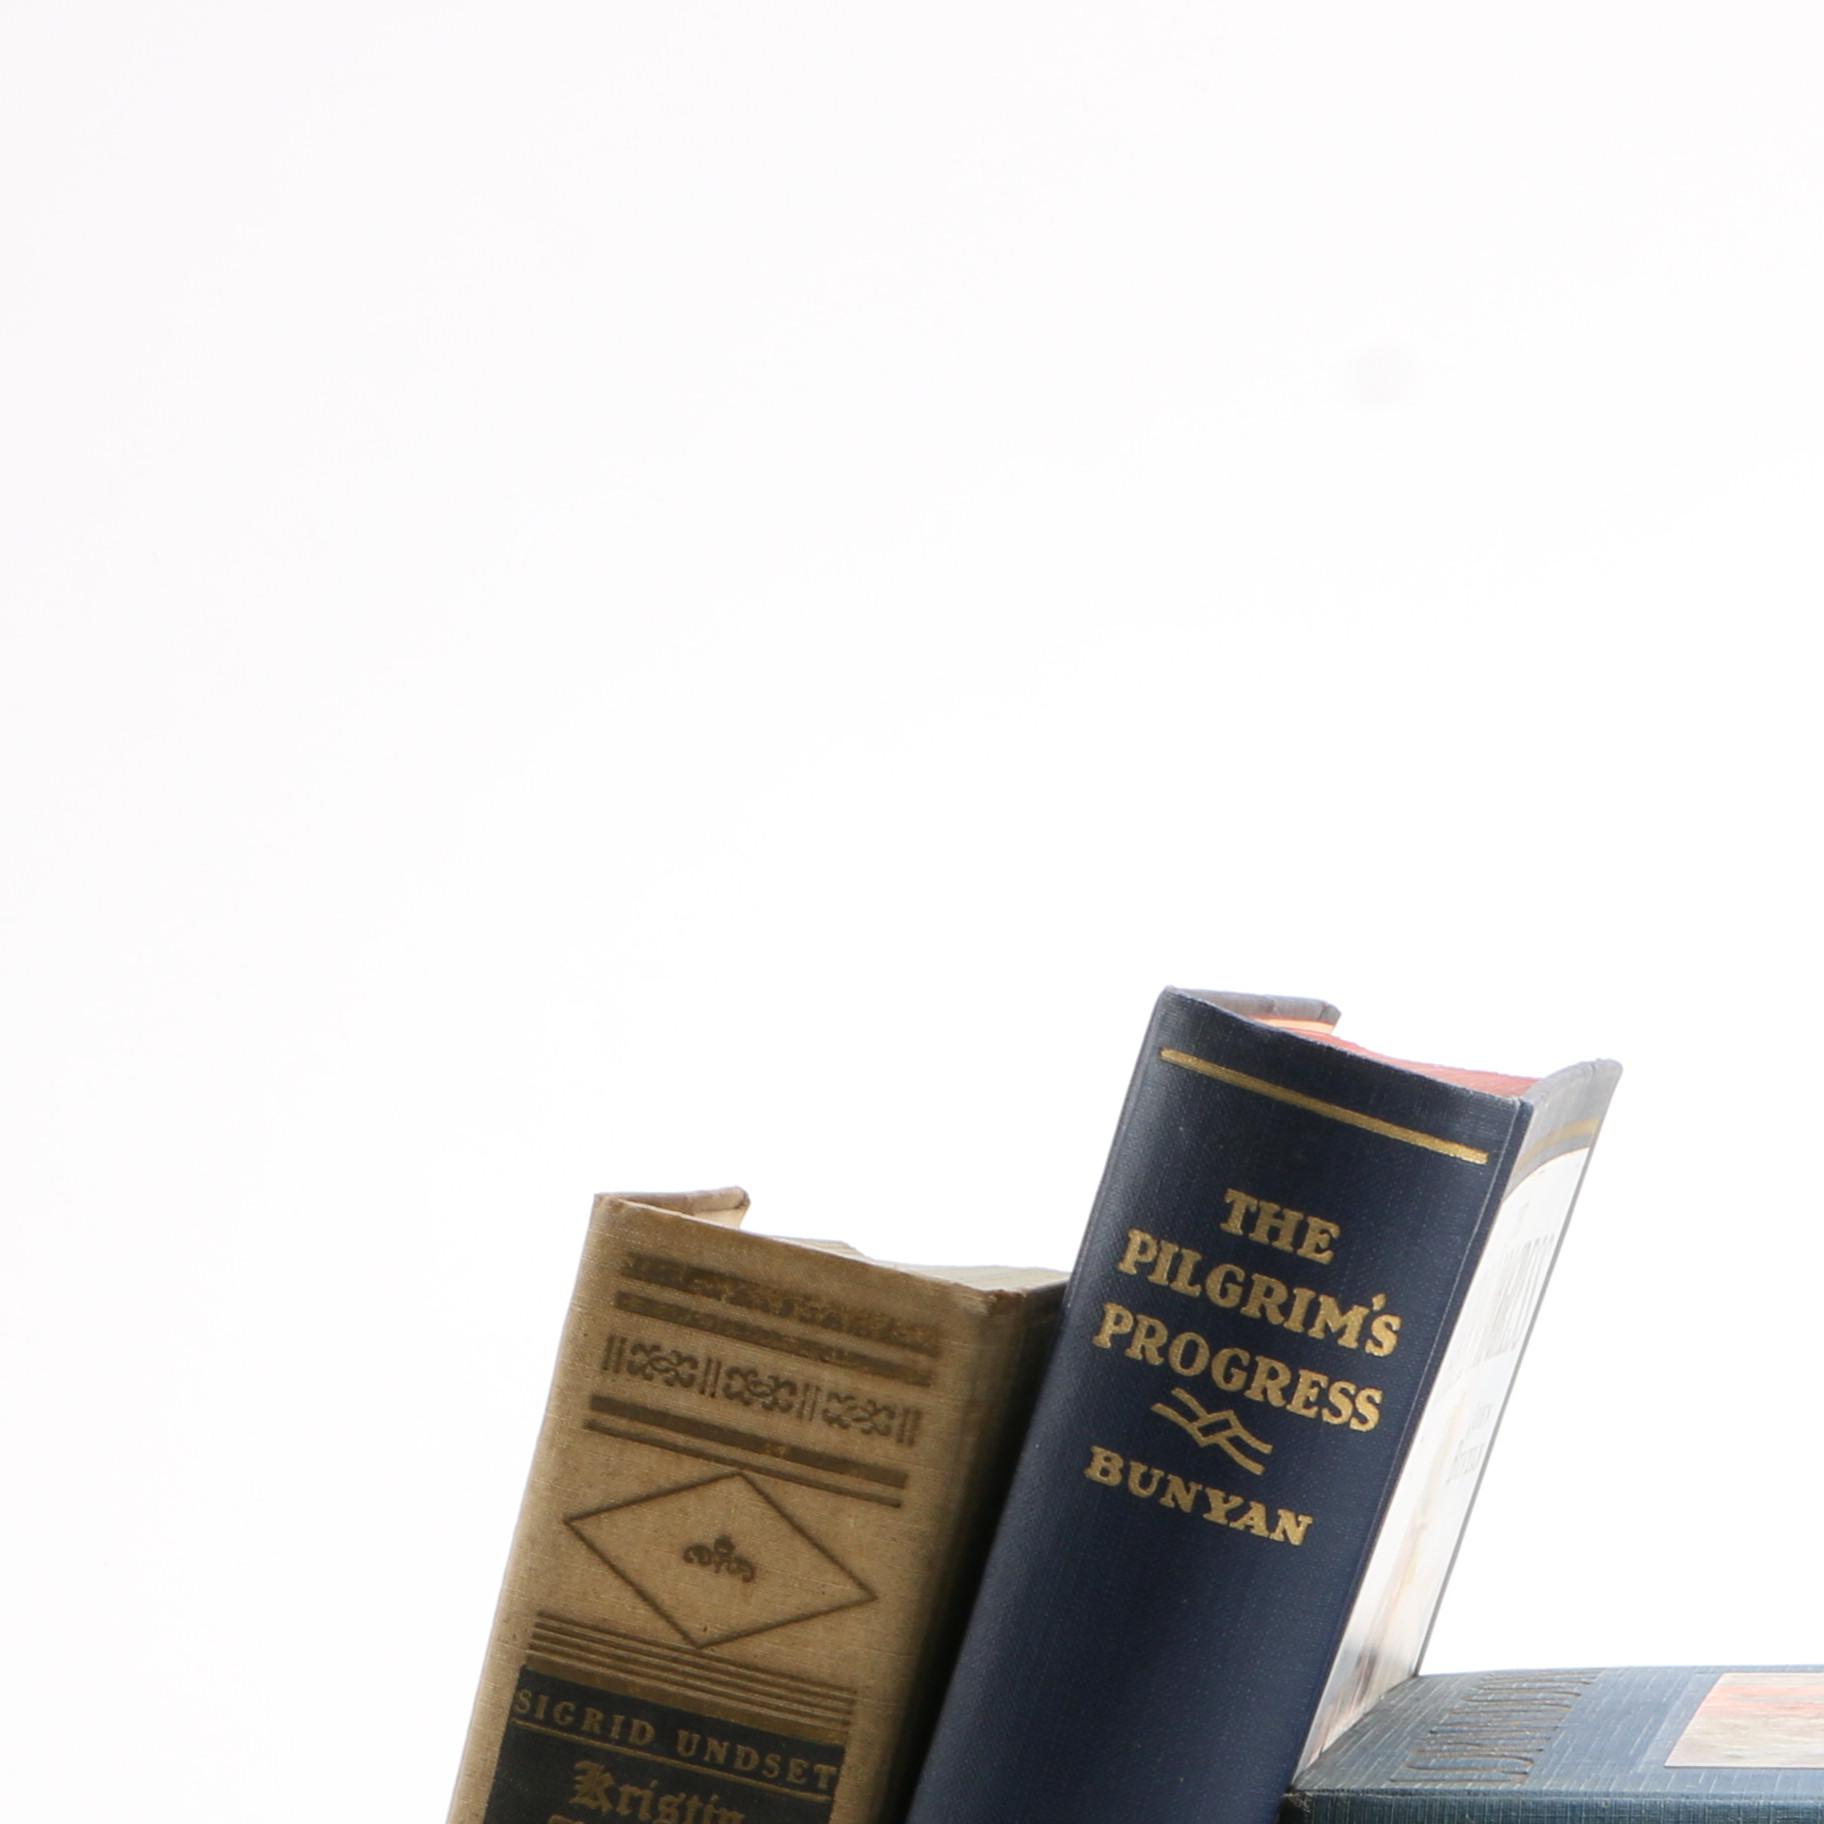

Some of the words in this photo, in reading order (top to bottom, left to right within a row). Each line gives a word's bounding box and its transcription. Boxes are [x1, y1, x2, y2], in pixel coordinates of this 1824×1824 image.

[1219, 1187, 1342, 1266] THE
[1117, 1228, 1402, 1358] PILGRIM'S
[1092, 1302, 1384, 1433] PROGRESS
[1084, 1445, 1314, 1546] BUNYAN
[514, 1688, 656, 1747] SIGRID
[677, 1727, 840, 1790] UNDSET
